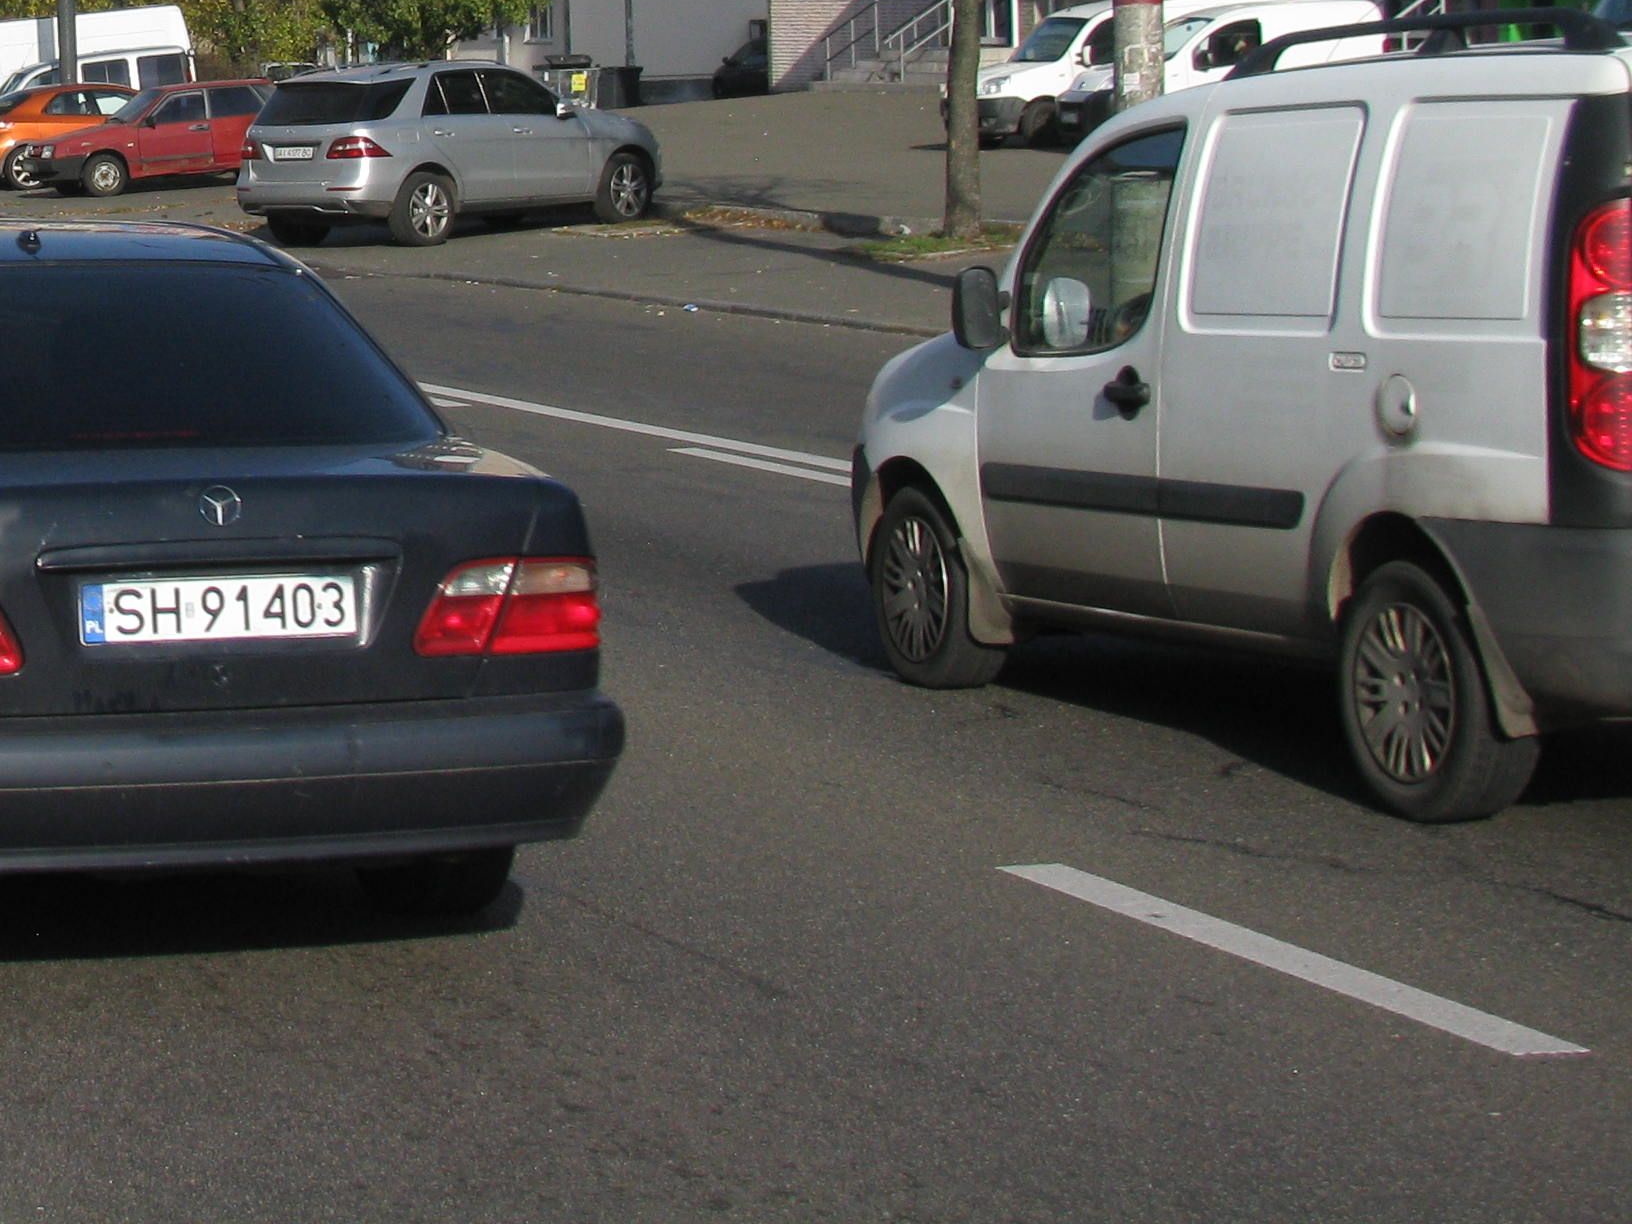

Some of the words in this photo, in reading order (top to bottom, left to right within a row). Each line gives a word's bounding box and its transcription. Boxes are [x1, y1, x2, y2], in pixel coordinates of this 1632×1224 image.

[114, 587, 182, 635] SH
[201, 581, 346, 633] 91403
[85, 621, 103, 634] PL
